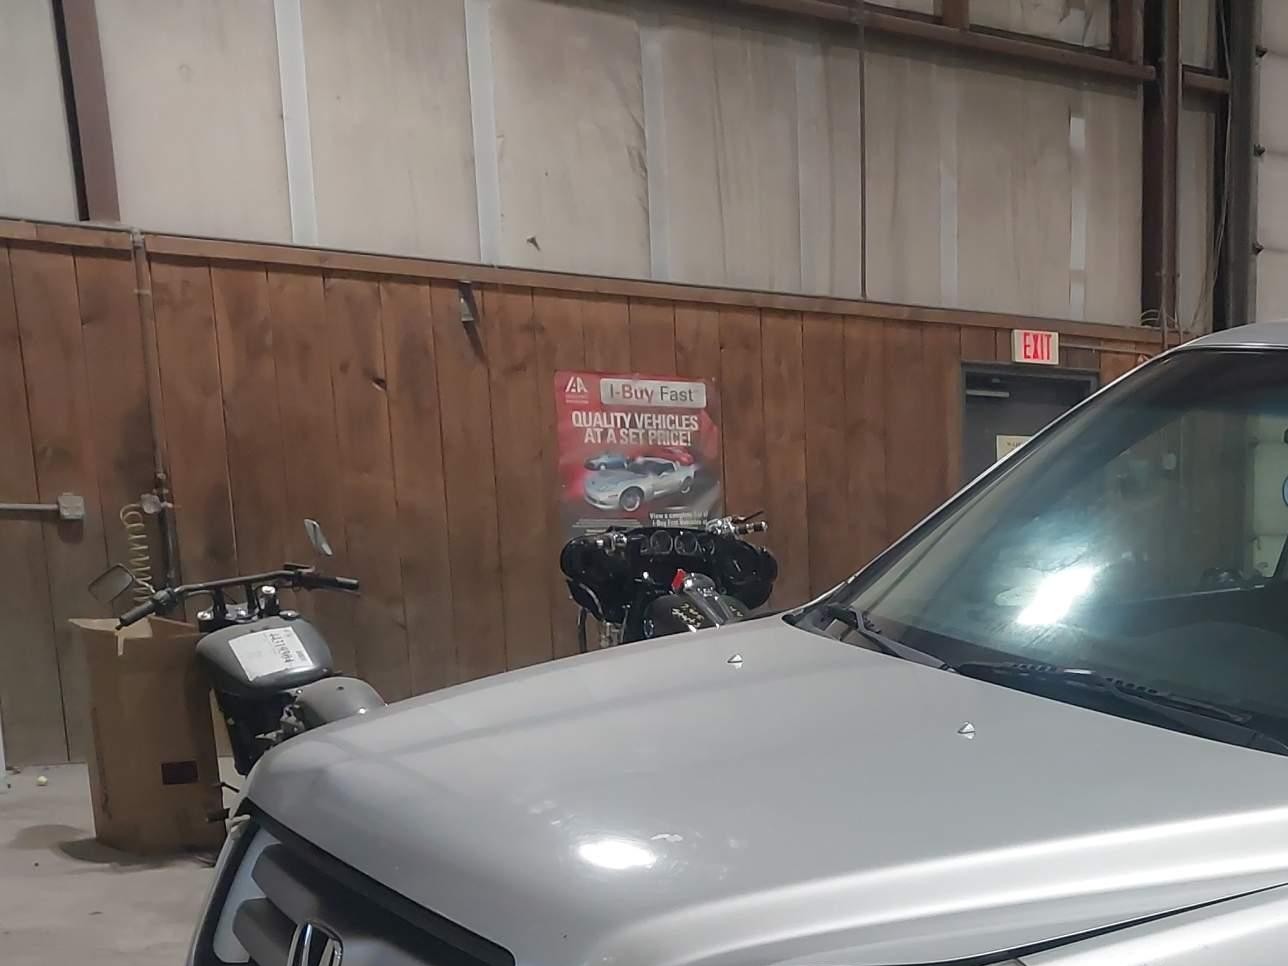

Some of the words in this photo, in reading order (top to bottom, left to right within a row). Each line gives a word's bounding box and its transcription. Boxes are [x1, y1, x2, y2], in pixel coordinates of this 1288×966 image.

[1023, 332, 1053, 360] EXIT
[609, 383, 654, 402] I-Buy
[660, 386, 695, 402] Fast
[572, 410, 632, 429] QUALITY
[634, 413, 699, 431] VEHICLES
[584, 428, 604, 443] AT
[606, 428, 617, 443] A
[620, 429, 644, 445] SET
[649, 430, 692, 447] PRICE!
